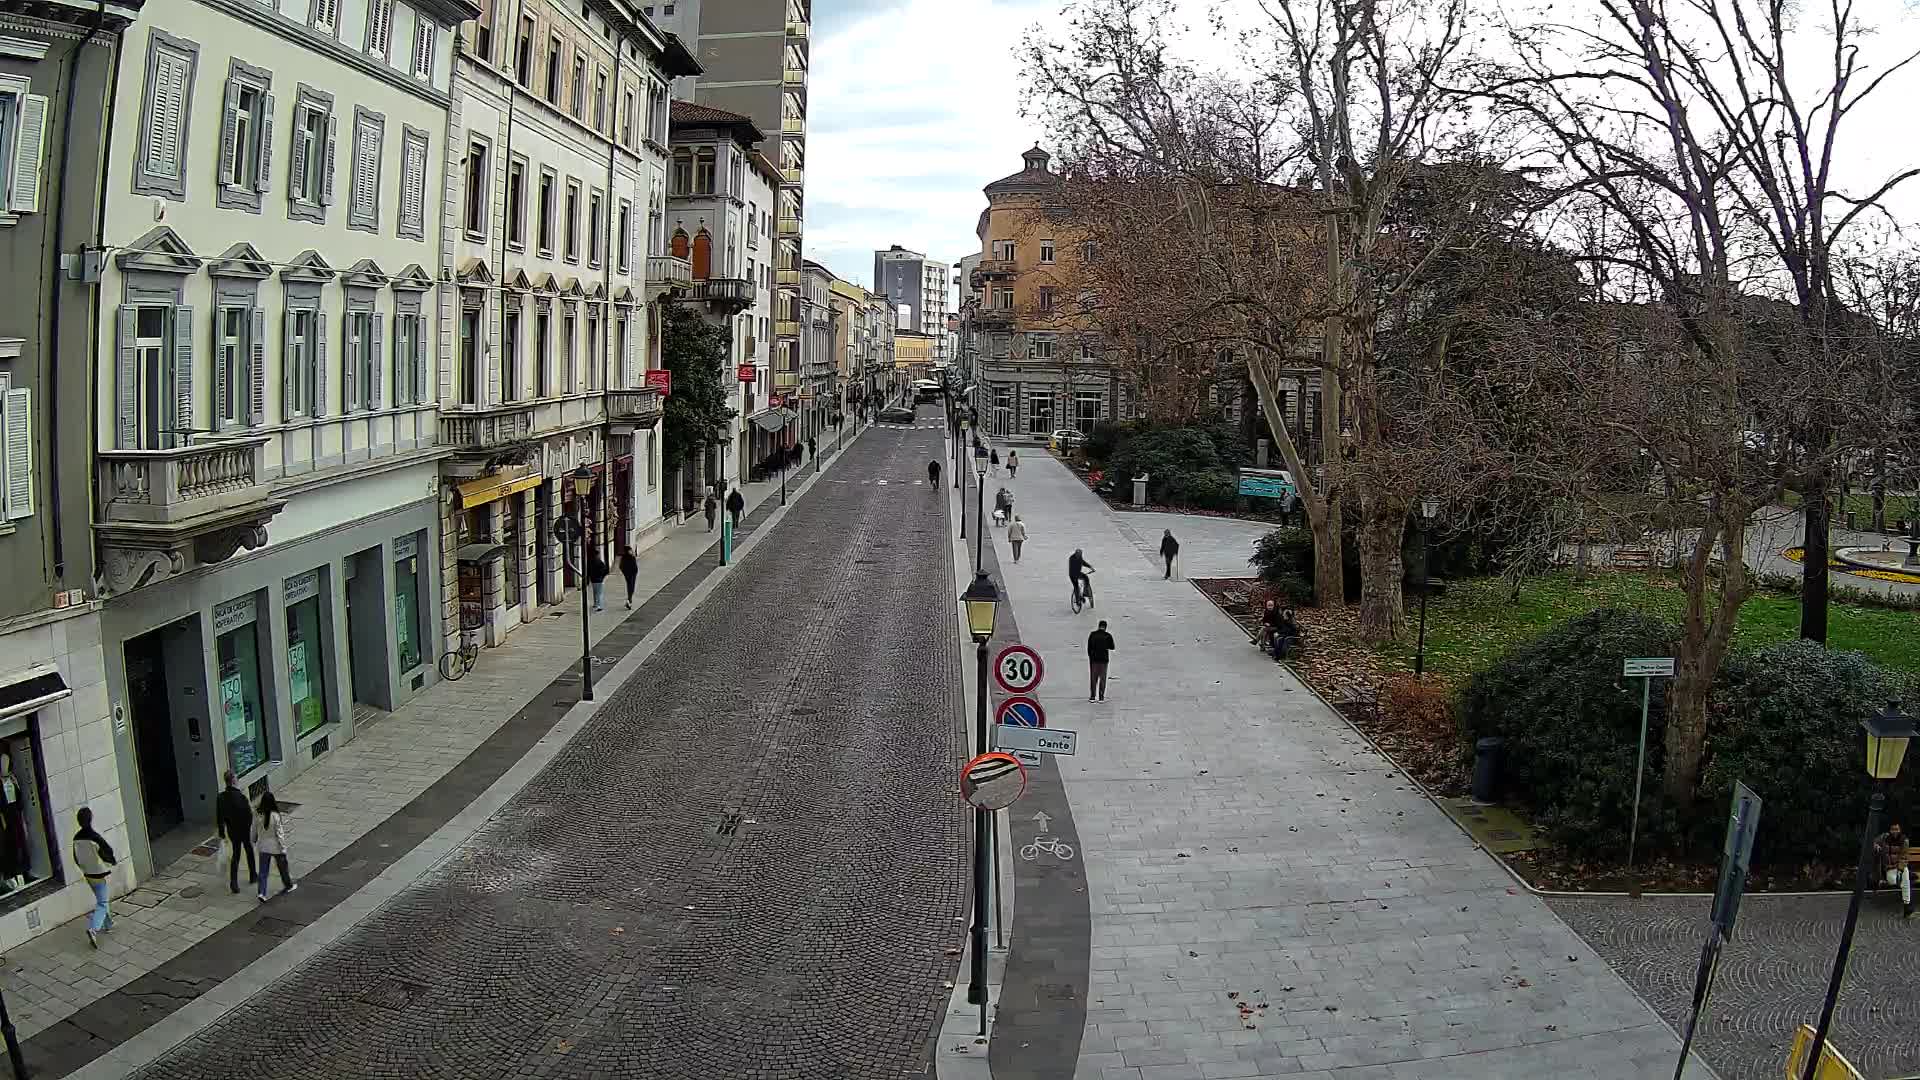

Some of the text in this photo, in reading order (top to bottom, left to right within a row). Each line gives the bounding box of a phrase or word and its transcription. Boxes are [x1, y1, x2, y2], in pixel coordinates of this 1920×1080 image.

[1005, 658, 1033, 681] 30
[222, 678, 240, 699] 130
[1038, 738, 1070, 750] Dante
